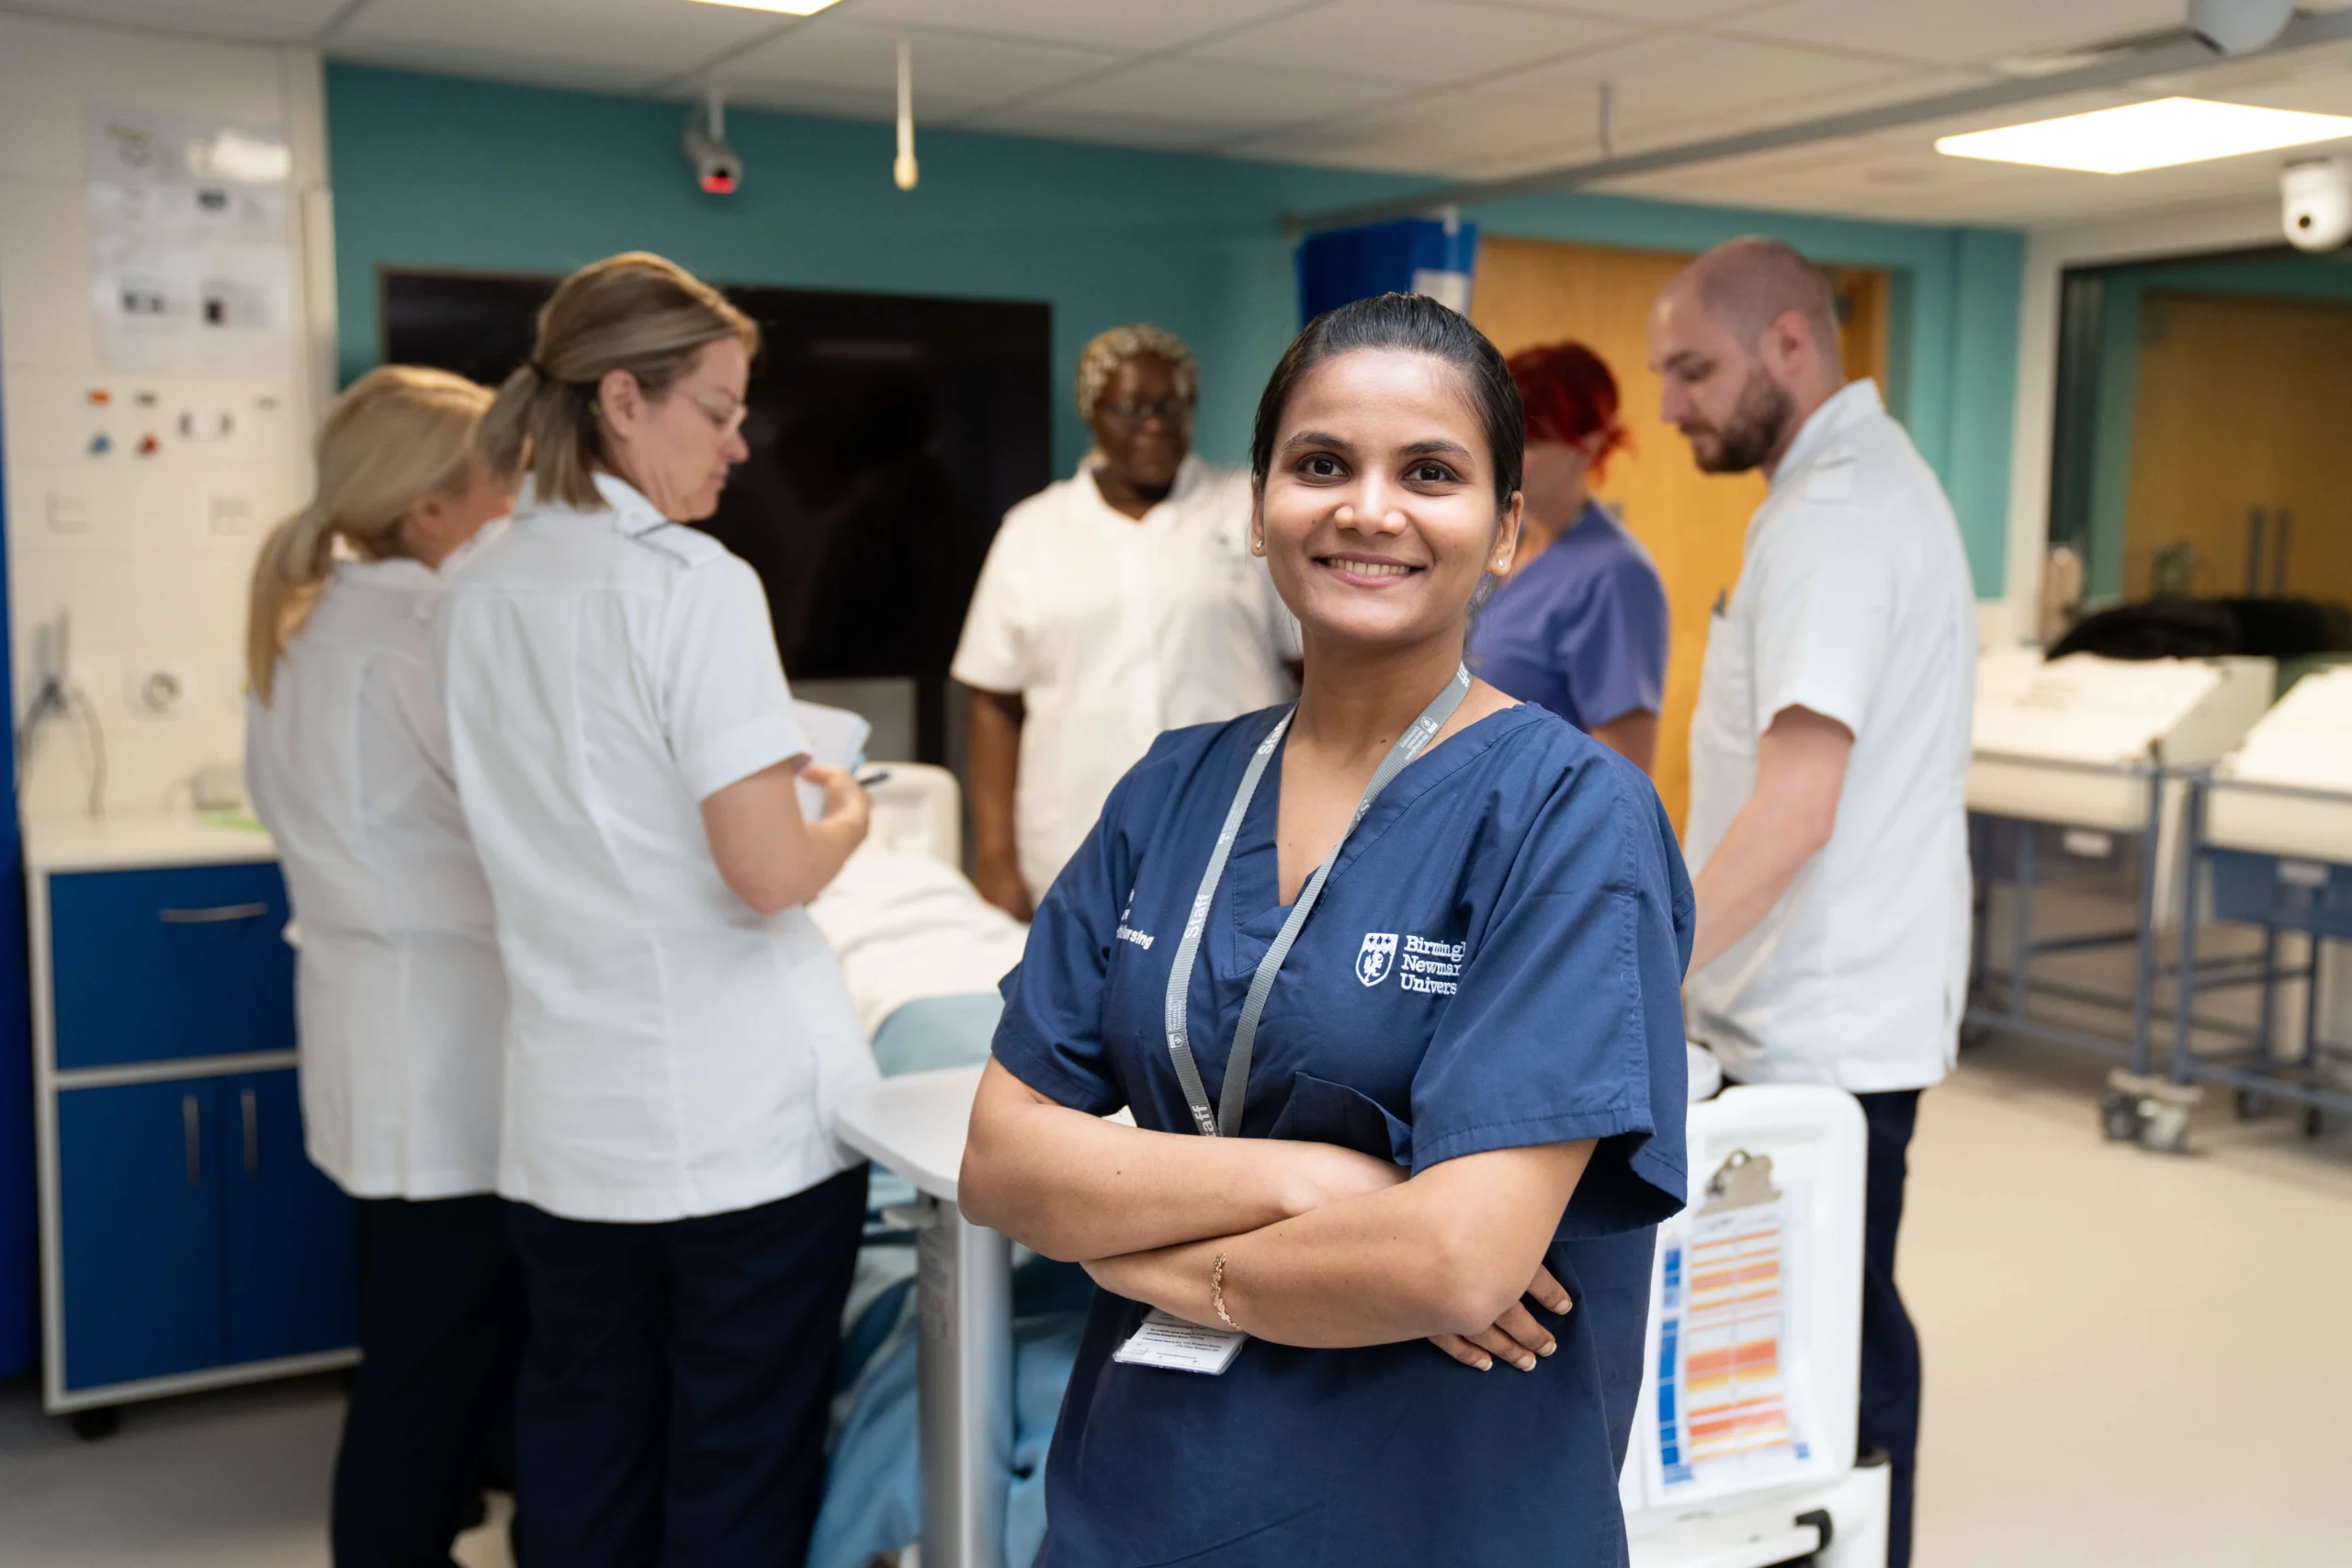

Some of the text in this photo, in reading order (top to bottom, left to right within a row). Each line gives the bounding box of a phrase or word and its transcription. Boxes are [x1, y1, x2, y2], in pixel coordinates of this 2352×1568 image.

[1185, 894, 1211, 939] Staff
[1399, 973, 1458, 996] Univers
[1192, 1105, 1216, 1137] aff
